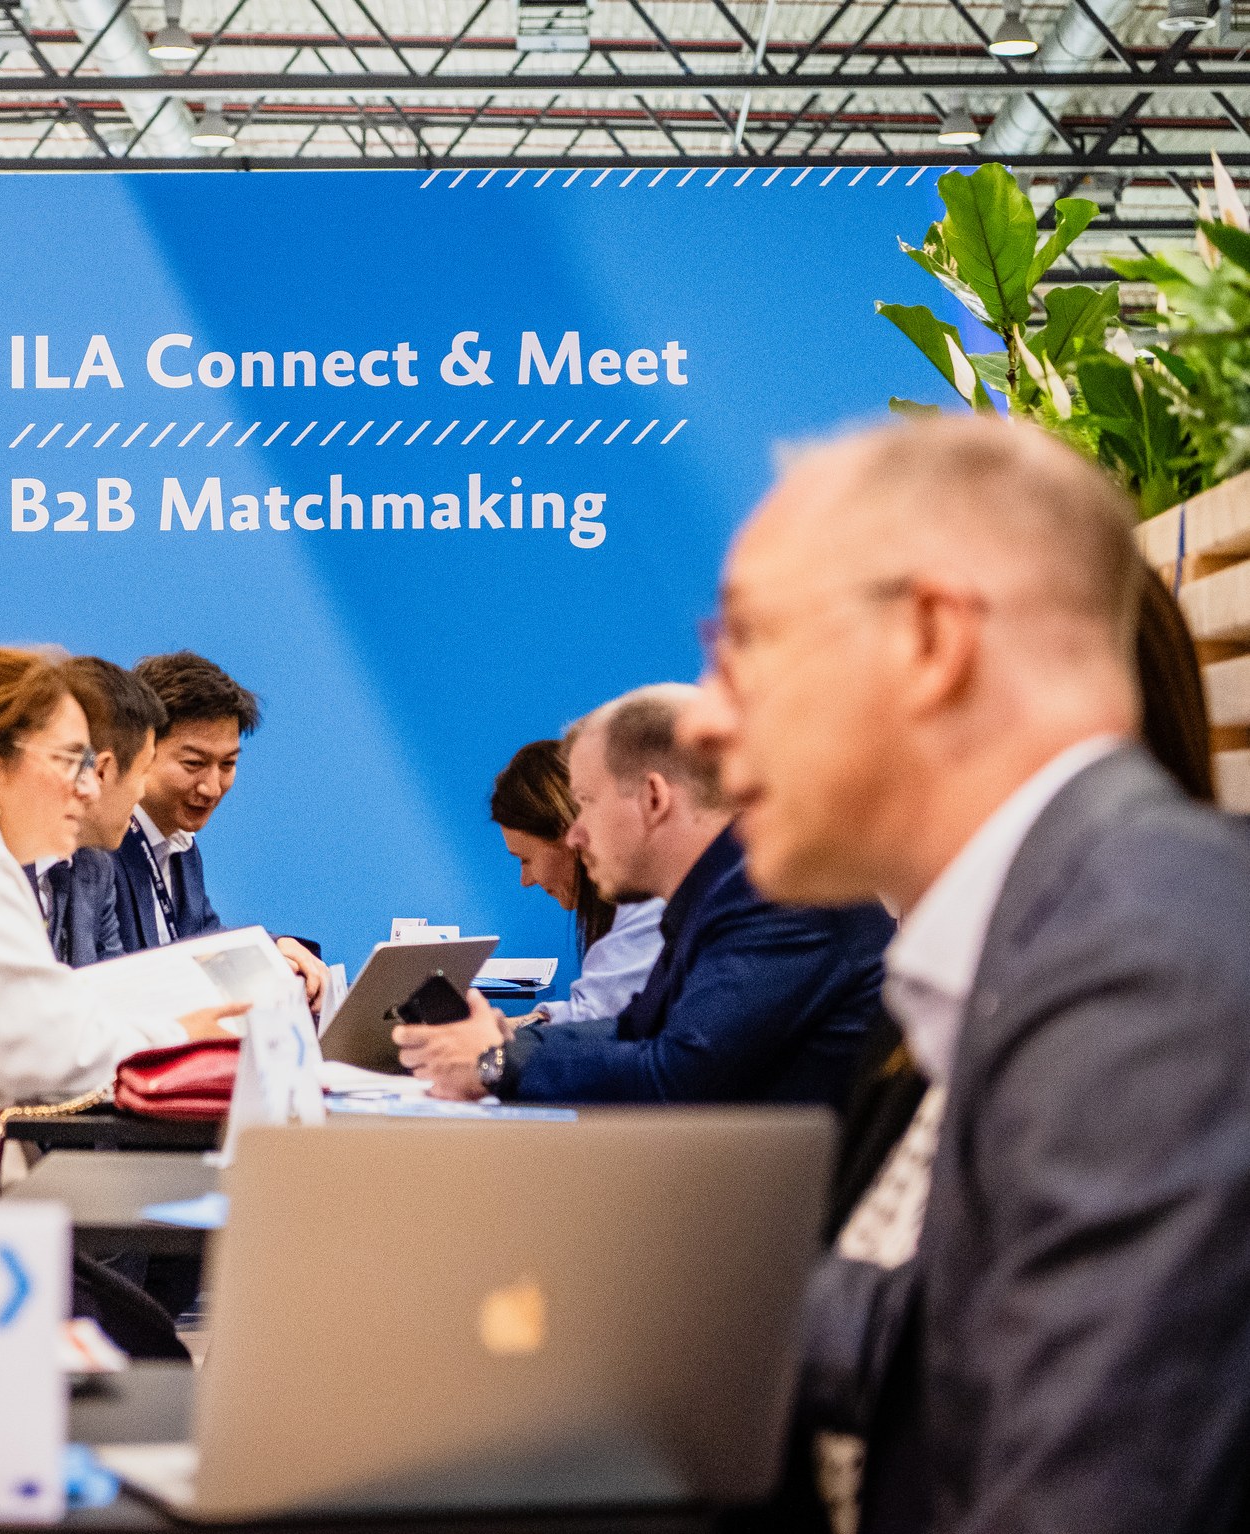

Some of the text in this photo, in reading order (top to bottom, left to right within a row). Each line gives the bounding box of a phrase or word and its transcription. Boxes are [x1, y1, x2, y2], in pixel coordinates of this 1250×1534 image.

[11, 331, 689, 389] ILA Connect & Meet
[11, 474, 607, 549] B2B Matchmaking
